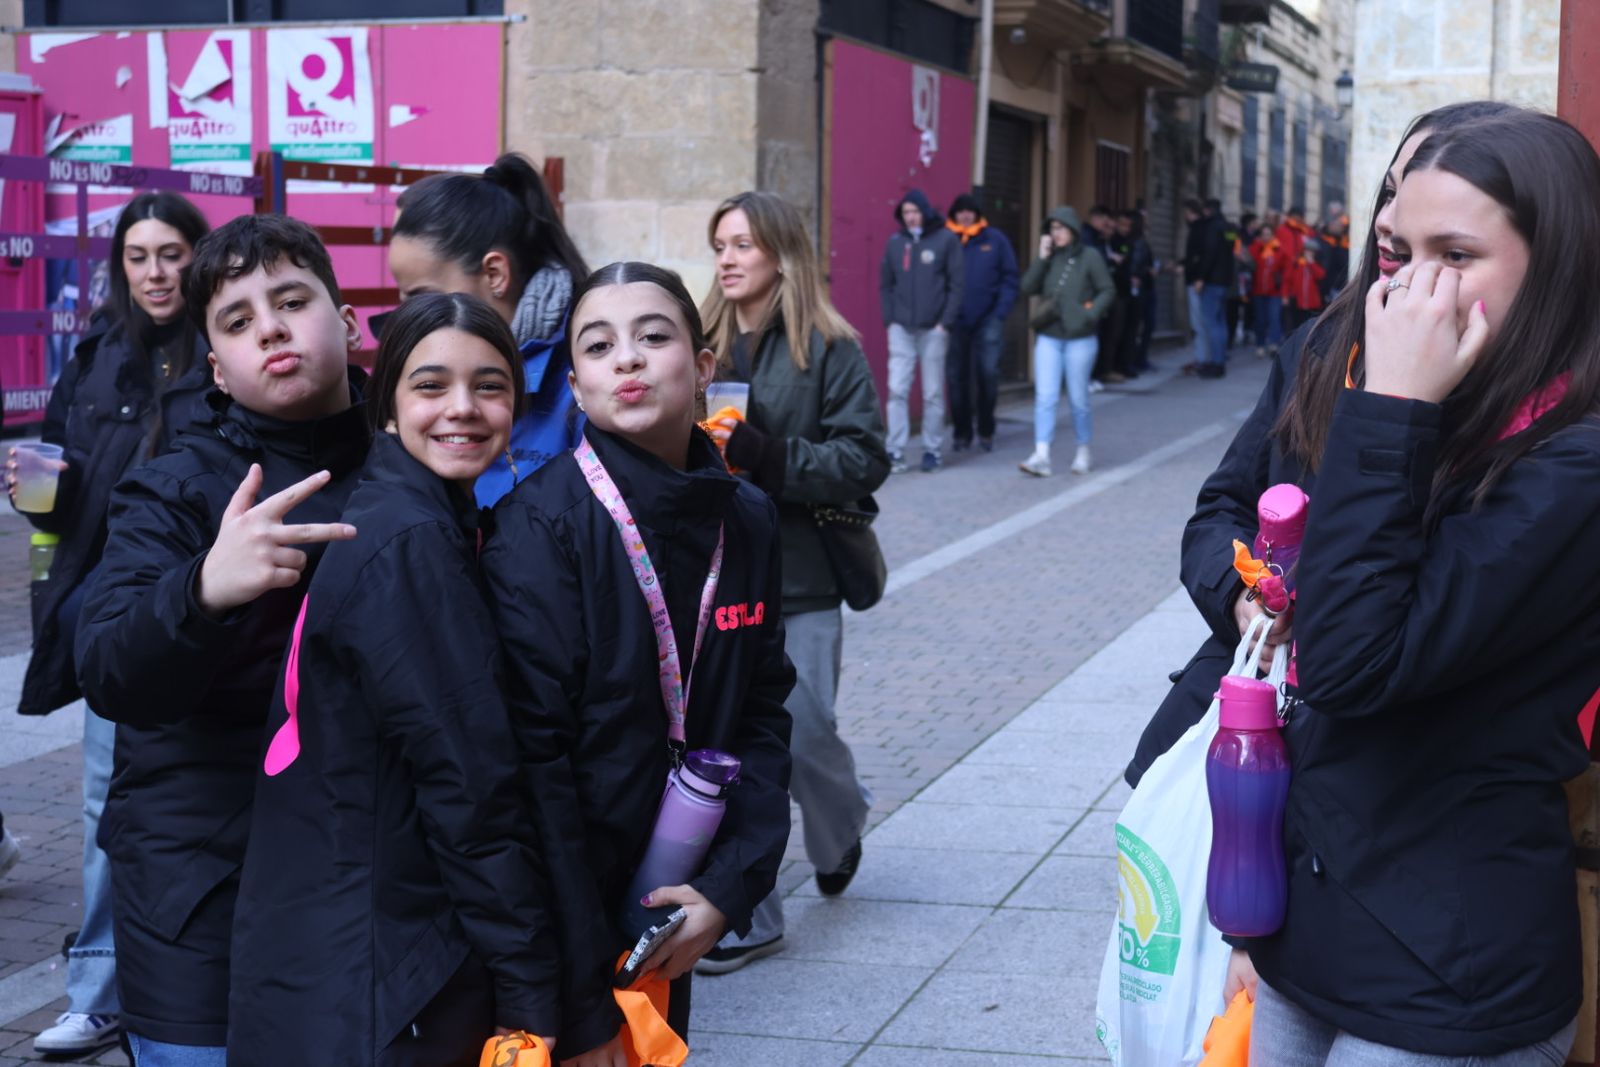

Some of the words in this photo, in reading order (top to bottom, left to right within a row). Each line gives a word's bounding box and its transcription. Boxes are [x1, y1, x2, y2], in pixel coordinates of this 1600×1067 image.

[50, 161, 71, 181] NO
[90, 163, 111, 183] NO
[190, 174, 209, 192] NO
[225, 176, 243, 194] NO
[10, 236, 33, 258] NO
[52, 311, 75, 332] NO
